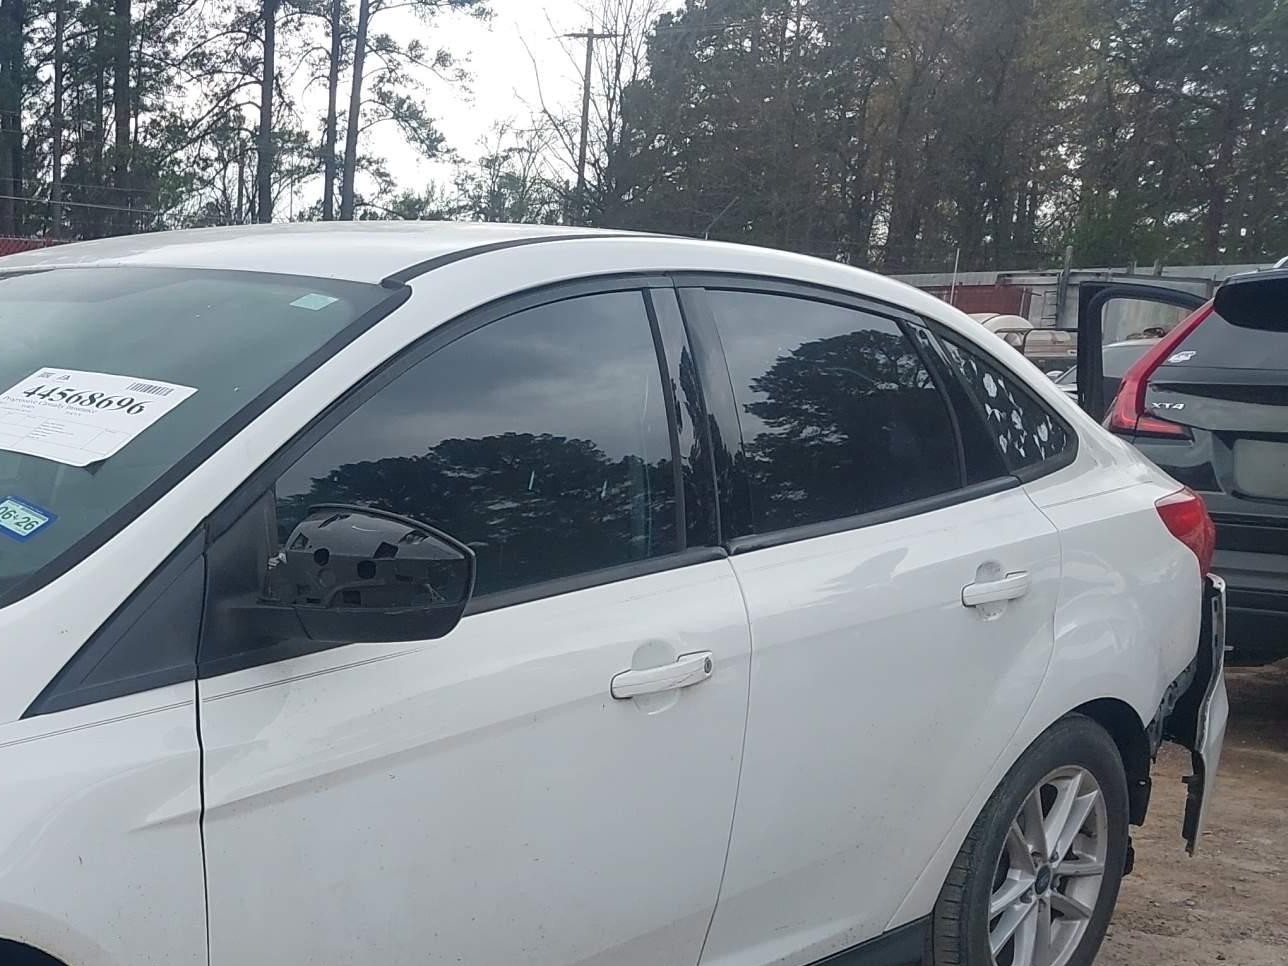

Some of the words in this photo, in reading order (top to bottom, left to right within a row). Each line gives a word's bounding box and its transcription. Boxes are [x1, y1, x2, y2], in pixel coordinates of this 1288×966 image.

[22, 384, 149, 416] 44568696
[1151, 402, 1185, 410] XT4
[14, 516, 39, 531] 26
